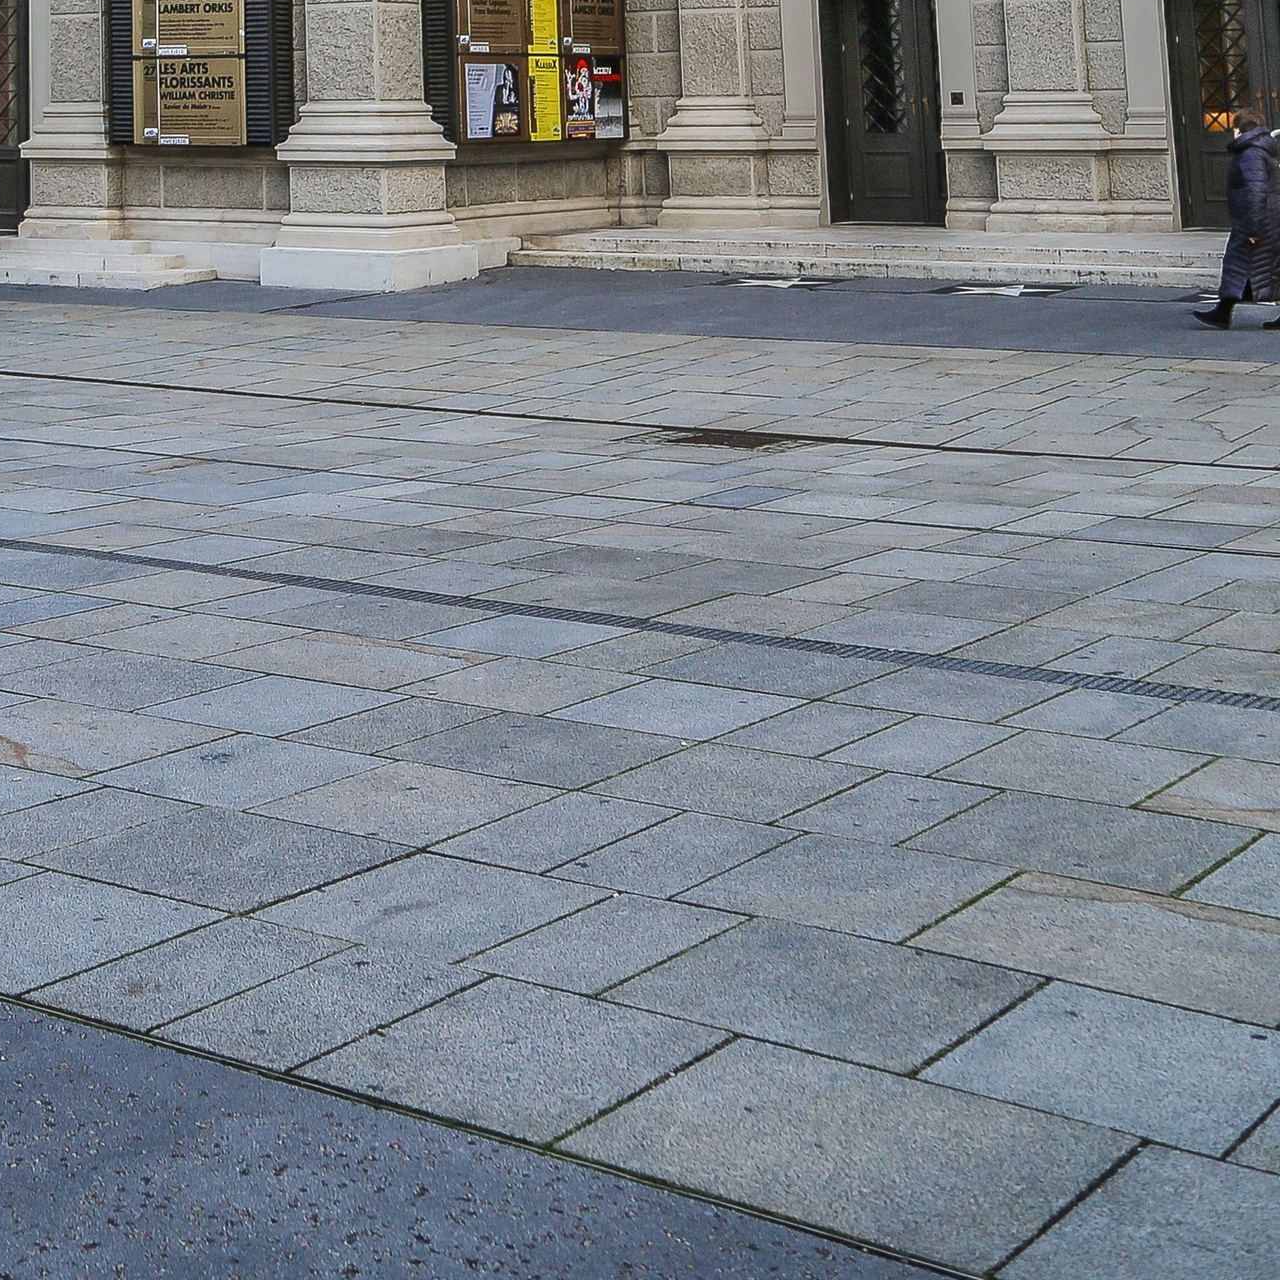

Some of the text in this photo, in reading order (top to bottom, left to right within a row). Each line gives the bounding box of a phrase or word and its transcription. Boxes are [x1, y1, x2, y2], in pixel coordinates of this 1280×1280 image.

[159, 3, 233, 14] LAMBERT ORKIS
[160, 62, 208, 75] LES ARTS
[160, 76, 234, 89] FLORISSANTS
[160, 91, 235, 100] WILLIAM CHRISTIE
